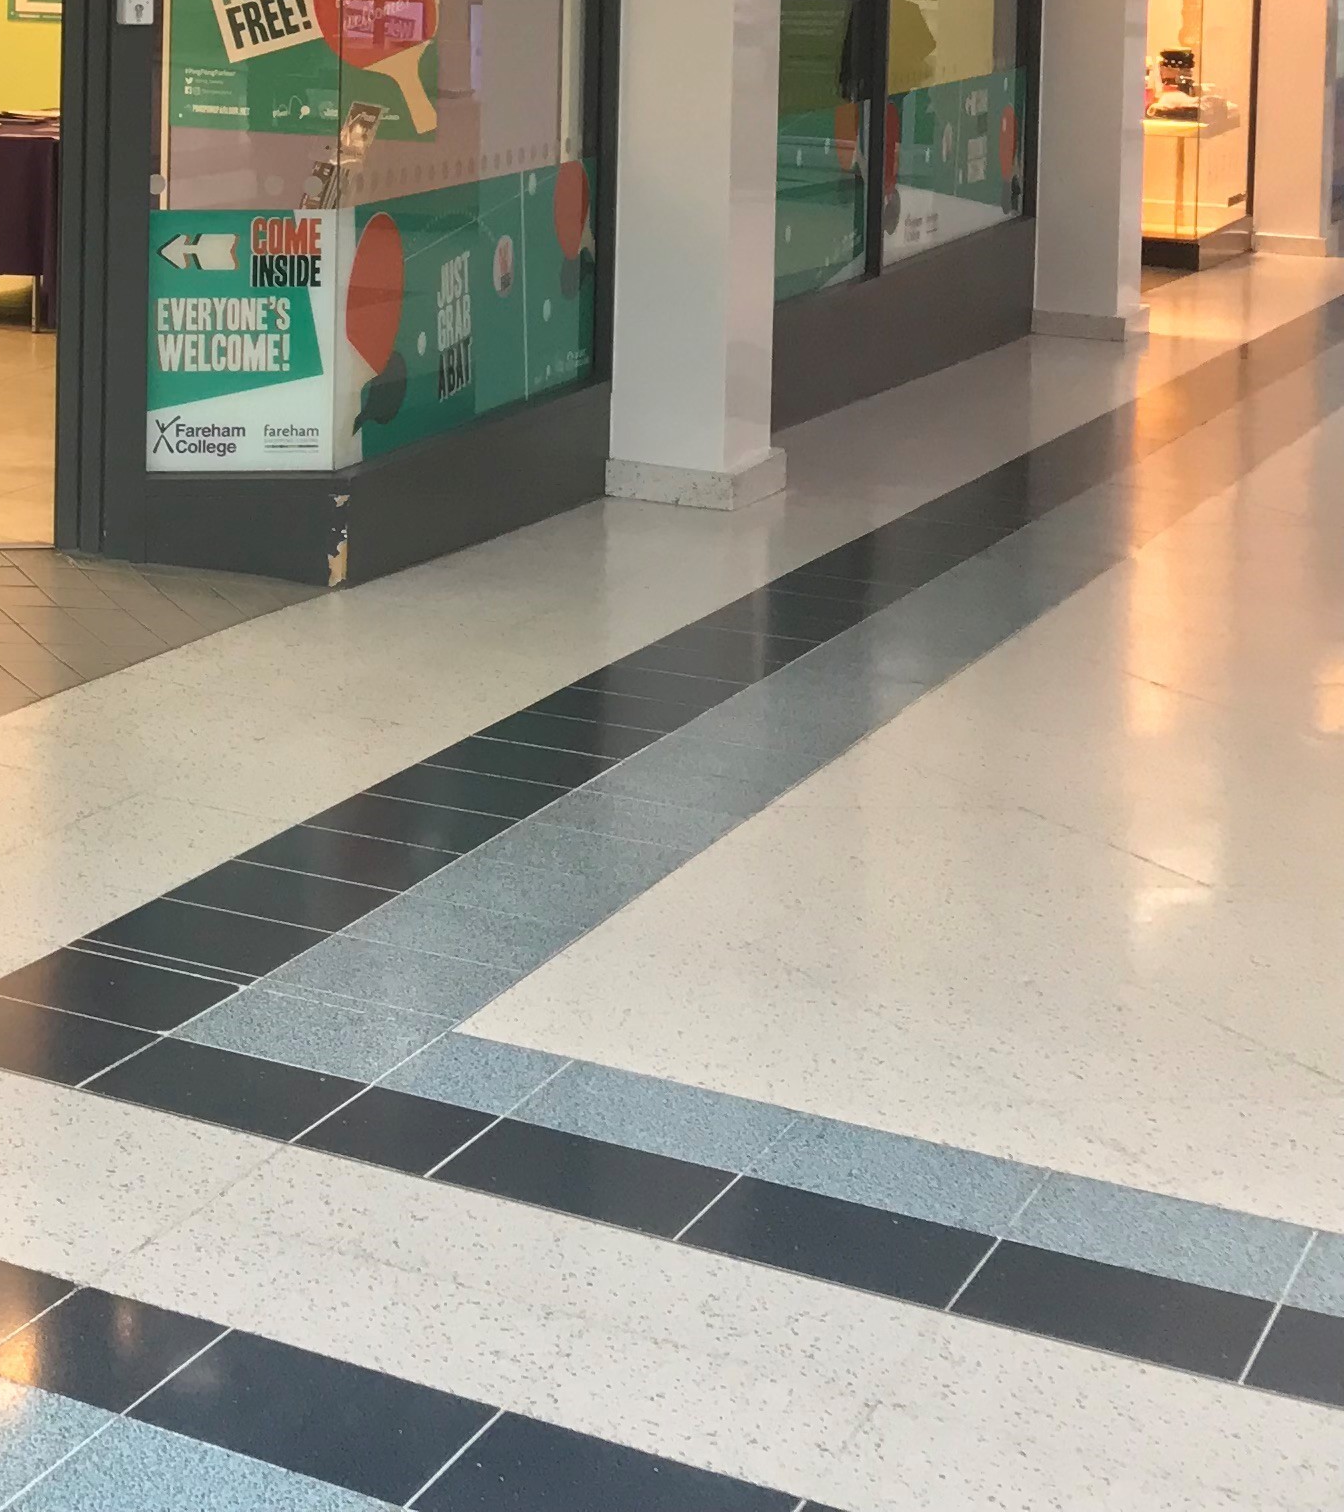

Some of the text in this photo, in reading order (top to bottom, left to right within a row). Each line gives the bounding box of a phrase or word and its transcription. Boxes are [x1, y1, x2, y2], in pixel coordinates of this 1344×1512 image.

[250, 216, 321, 255] COME
[250, 255, 321, 287] INSIDE
[437, 250, 470, 308] JUST
[157, 297, 291, 331] EVERYONE'S
[437, 294, 471, 352] GRAB
[158, 334, 291, 372] WELCOME!
[176, 424, 245, 437] Fareham
[264, 424, 319, 437] fareham
[176, 440, 237, 457] College
